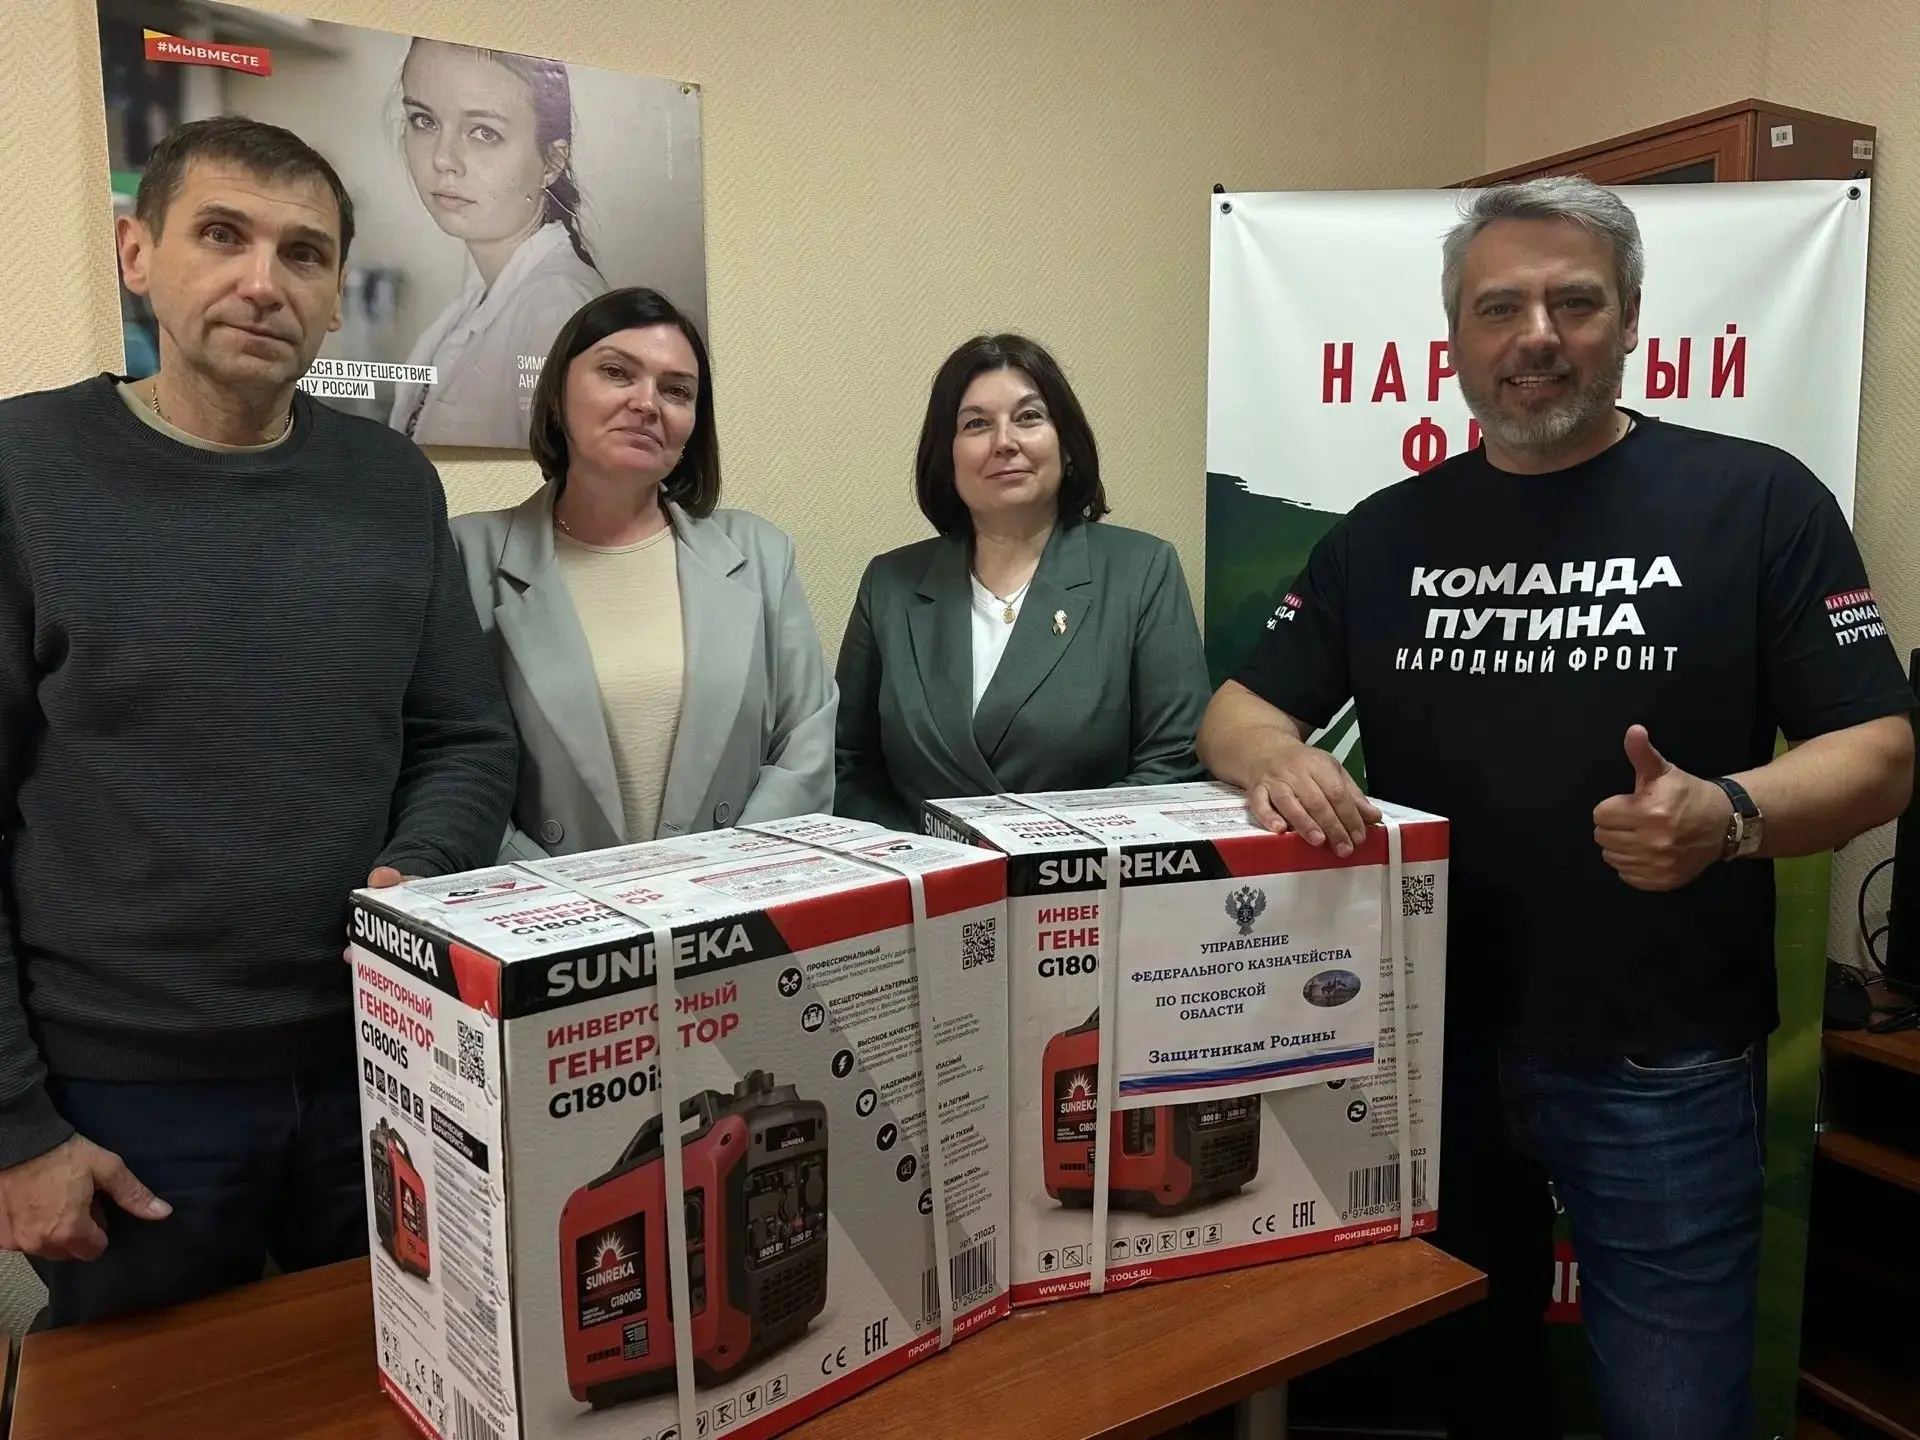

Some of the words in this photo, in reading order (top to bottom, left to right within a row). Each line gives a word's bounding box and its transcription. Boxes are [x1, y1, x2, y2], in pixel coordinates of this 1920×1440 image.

[157, 41, 259, 66] #МЫВМЕСТЕ
[310, 361, 332, 375] ЬСЯ
[336, 362, 344, 376] В
[347, 363, 432, 382] ПУТЕШЕСТВИЕ
[1323, 324, 1746, 403] НАРЫЙ
[322, 381, 369, 396] РОССИИ
[1410, 556, 1683, 598] КОМАНДА
[1425, 603, 1647, 641] ПУТИНА
[1829, 605, 1879, 628] КОМАН
[1835, 622, 1887, 646] ПУТИН
[1395, 646, 1555, 675] НАРОДНЫЙ
[1568, 645, 1678, 672] ФРОНТ
[1038, 849, 1201, 886] SUNREKA
[354, 907, 439, 978] SUNREKA
[1201, 935, 1289, 954] УПРАВЛЕНИЕ
[807, 945, 880, 972] ПРОФЕССИОНАЛЬНЫЙ
[1038, 954, 1099, 977] G180
[1131, 962, 1244, 982] ФЕДЕРАЛЬНОГО
[1248, 948, 1352, 970] КАЗНАЧЕЙСТВА
[357, 962, 432, 1020] ИНВЕРТОРНЫЙ
[829, 985, 879, 1007] БЕСЩЕТОЧНЫЙ
[879, 975, 919, 993] АЛЬТЕРНАТО
[1156, 994, 1176, 1007] ПО
[1181, 982, 1266, 1004] ПСКОВСКОЙ
[359, 988, 434, 1051] ГЕНЕРАТОР
[1180, 1003, 1244, 1021] ОБЛАСТИ
[361, 1020, 408, 1069] G1800iS
[549, 1013, 739, 1085] ГЕНЕРТОР
[857, 1031, 888, 1048] ВЫСОКОЕ
[889, 1021, 920, 1036] КАЧЕСТВО
[1148, 1040, 1265, 1063] Защитникам
[1270, 1030, 1336, 1049] Родины
[549, 1064, 662, 1118] G1800i
[1060, 1099, 1098, 1114] SUNREKA
[1334, 1226, 1392, 1242] ПРОИЗВЕДЕНО
[585, 1261, 635, 1290] SUNREKA
